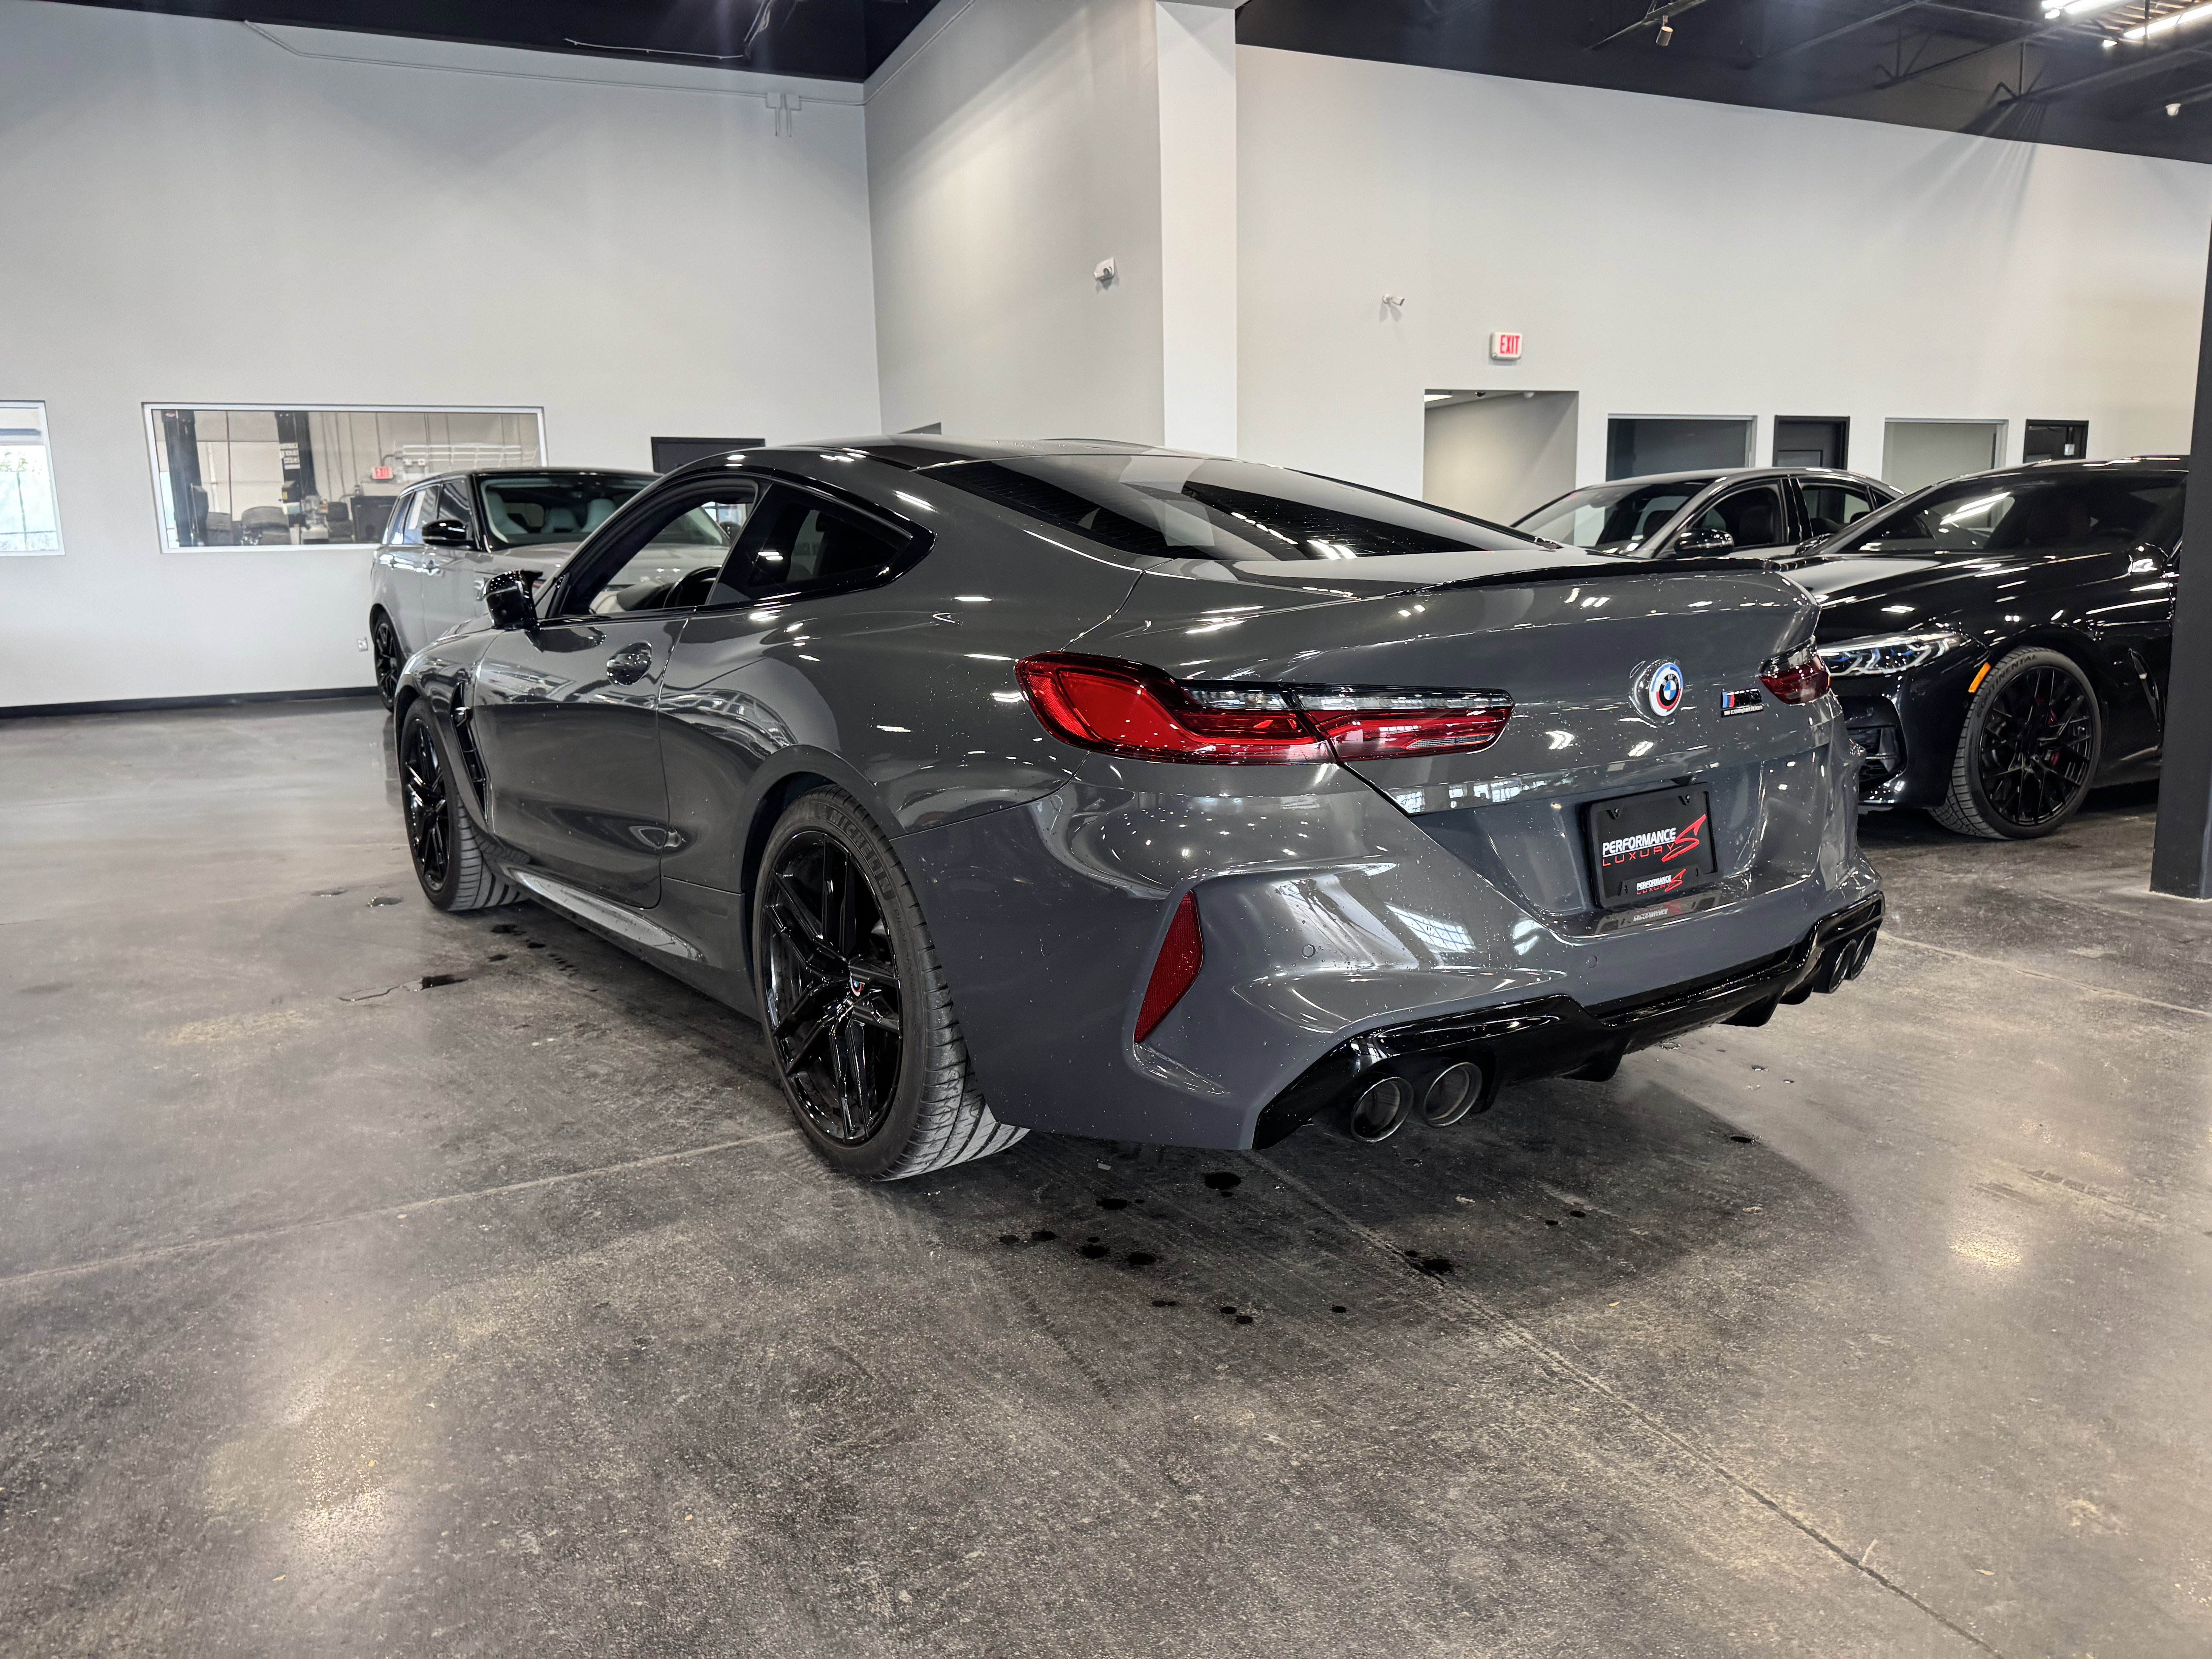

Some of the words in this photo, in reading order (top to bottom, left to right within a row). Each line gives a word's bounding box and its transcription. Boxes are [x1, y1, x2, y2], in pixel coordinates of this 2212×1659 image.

[1500, 335, 1520, 354] EXIT
[830, 810, 892, 893] MICHELIN
[1602, 828, 1676, 855] PERFORMANCE
[1637, 875, 1671, 890] PERFORMANCE
[895, 909, 907, 942] PILOT
